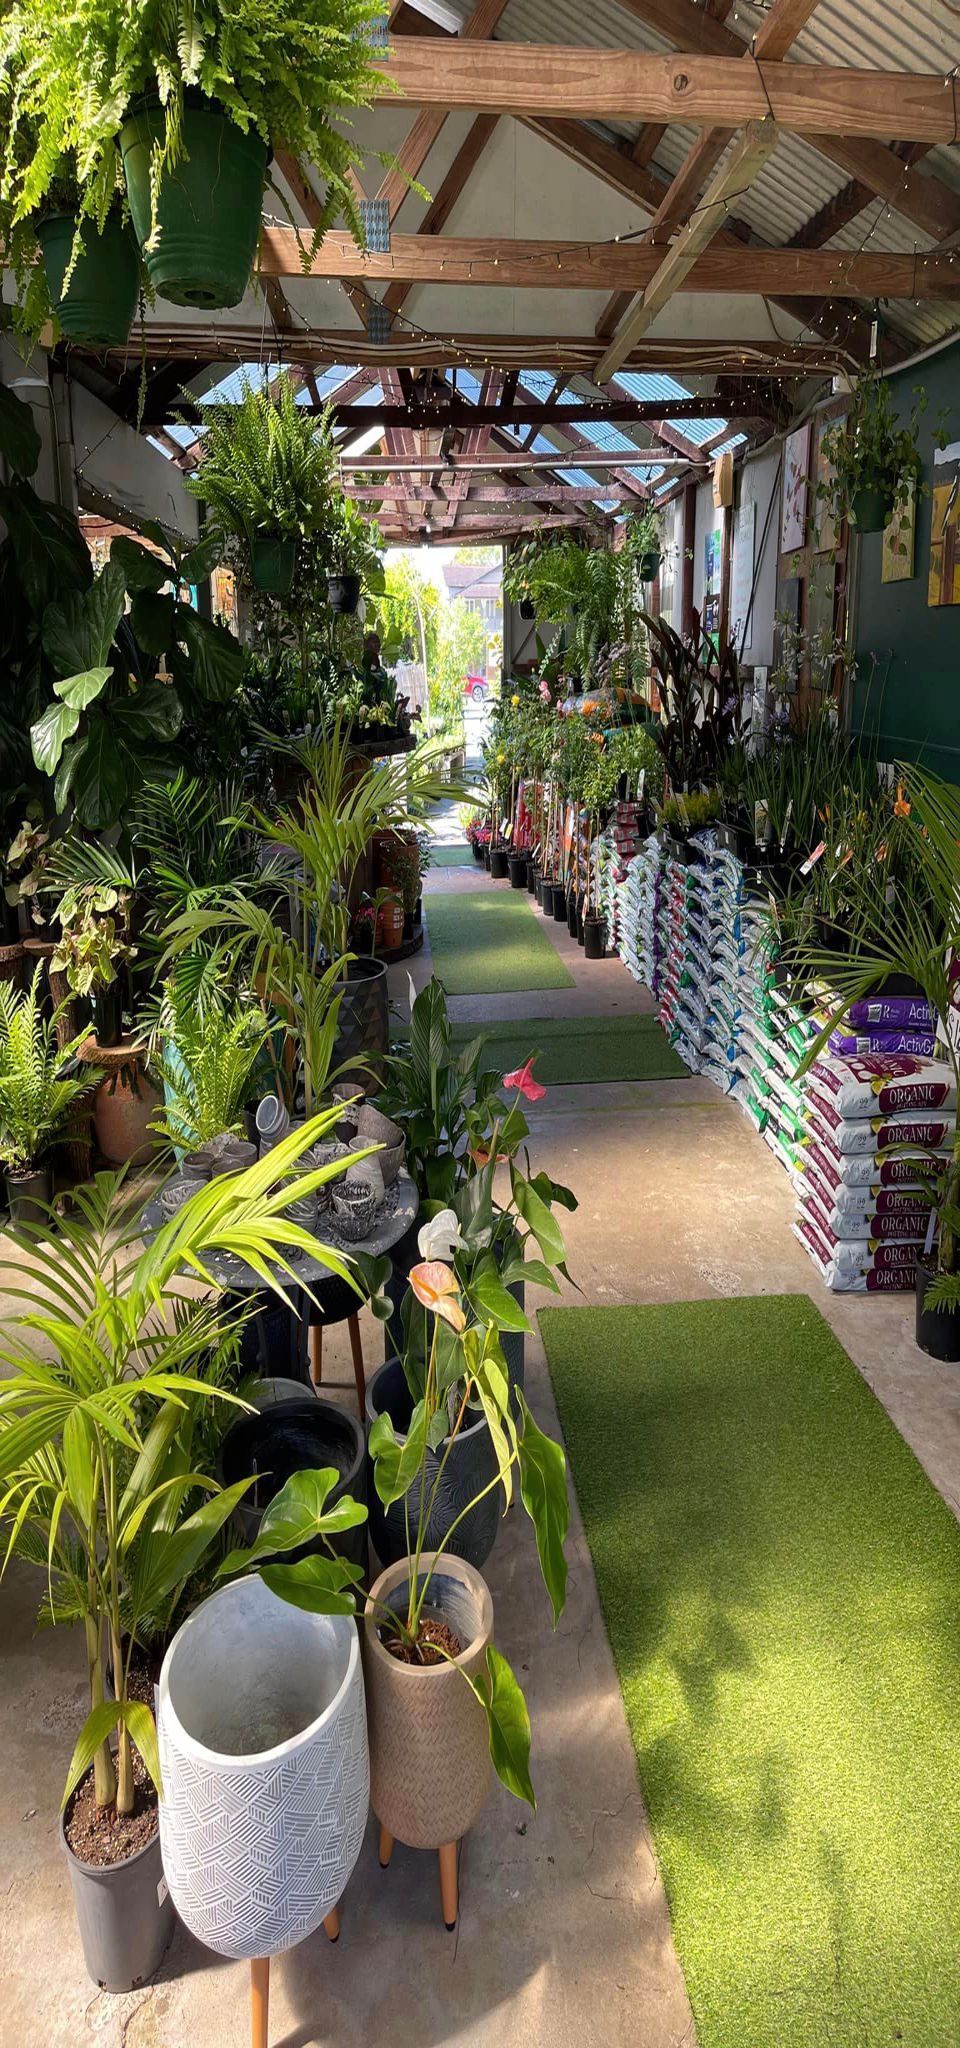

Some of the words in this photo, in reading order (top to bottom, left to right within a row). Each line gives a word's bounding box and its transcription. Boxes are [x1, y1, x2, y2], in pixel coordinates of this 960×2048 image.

[889, 1085, 935, 1104] ORGANIC
[887, 1126, 934, 1142] ORGANIC
[881, 1216, 928, 1232] ORGANIC
